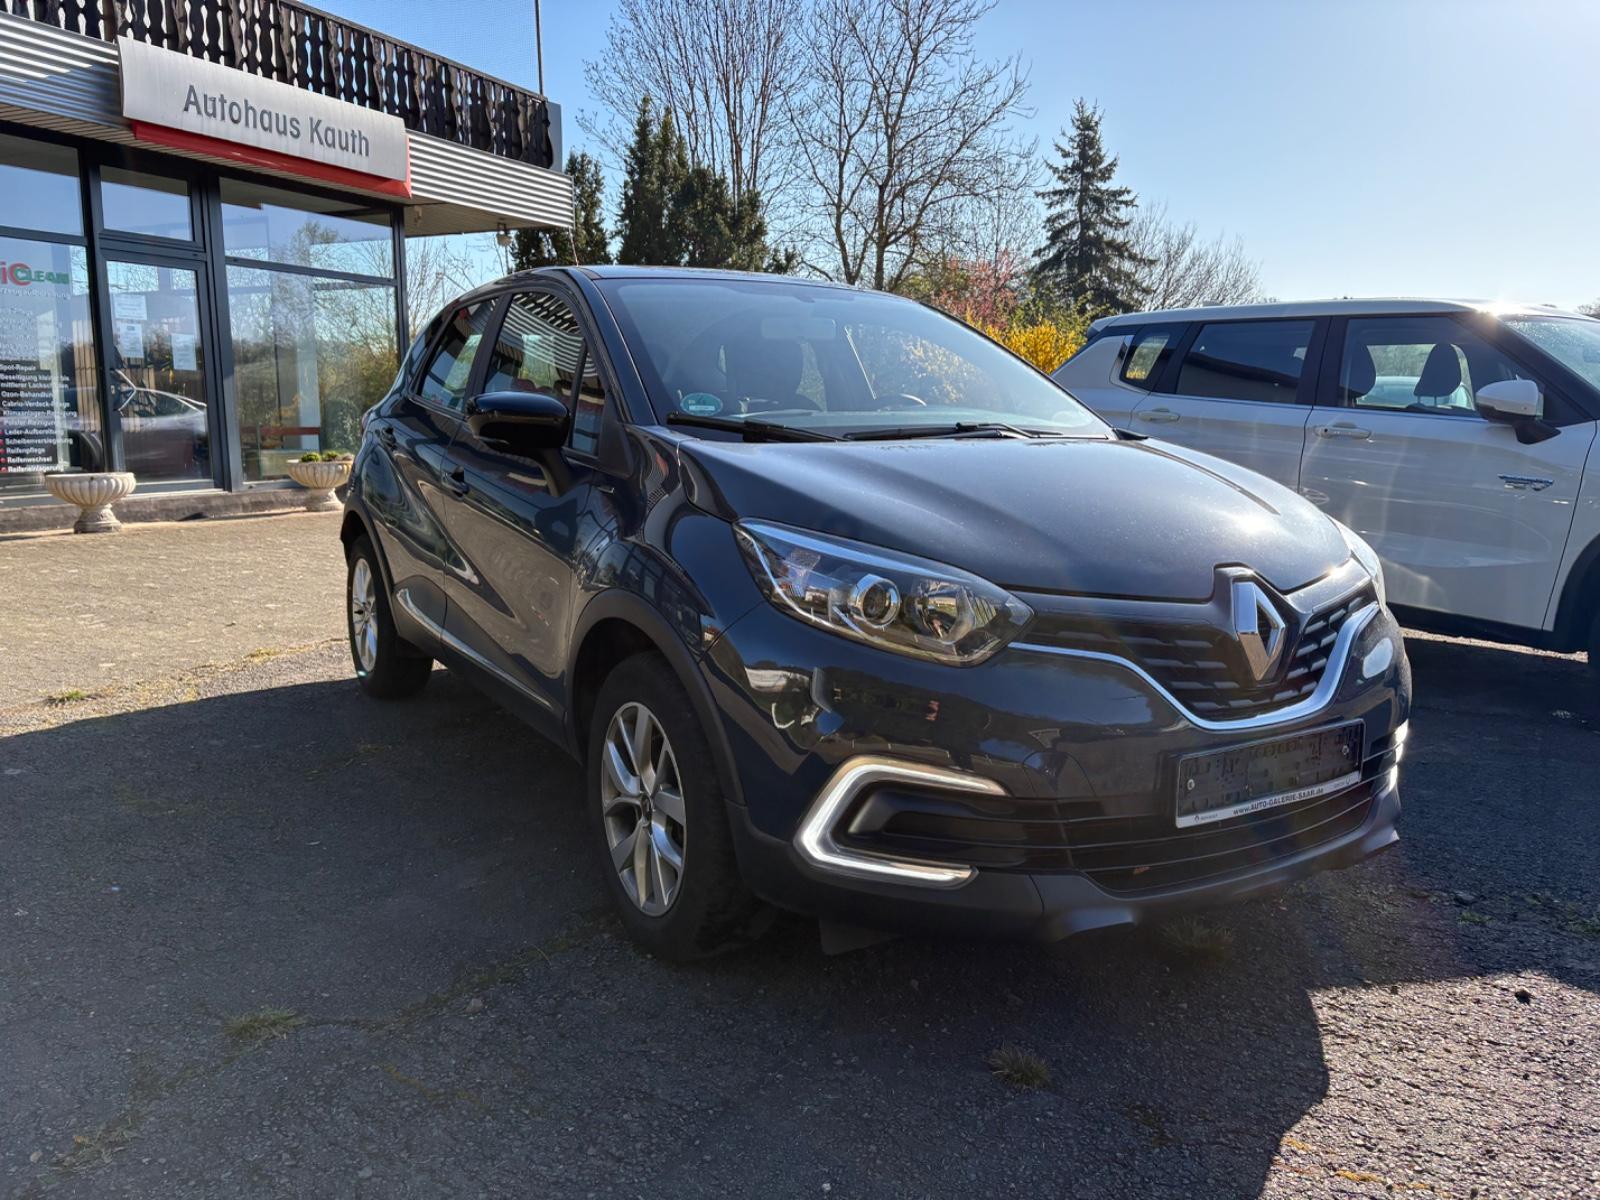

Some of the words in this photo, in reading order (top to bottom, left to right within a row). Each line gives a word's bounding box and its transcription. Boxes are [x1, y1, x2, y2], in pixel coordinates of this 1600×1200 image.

[183, 84, 301, 139] Autohaus
[308, 116, 370, 157] Kauth
[1, 390, 58, 399] Ozon-Behandlun
[2, 400, 70, 409] Cabrio-Verdeck-Pege
[6, 447, 46, 456] Reifenpflege
[7, 456, 53, 464] Reifenwechsel
